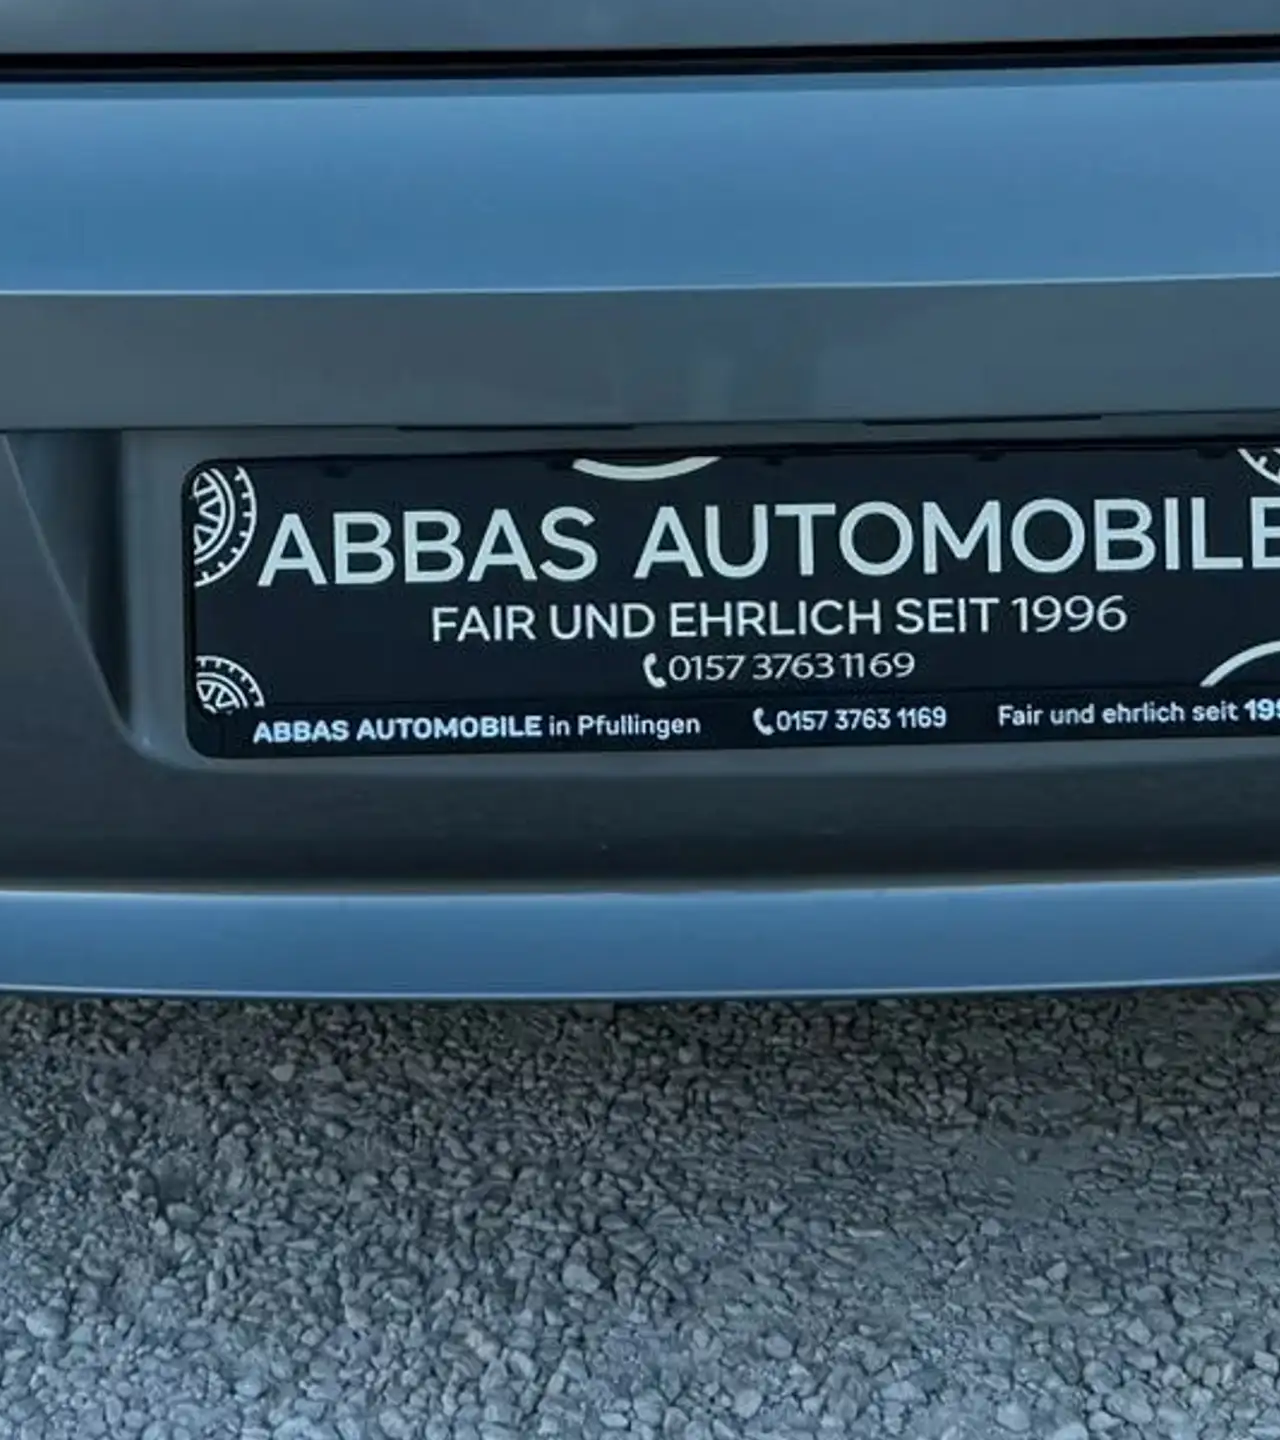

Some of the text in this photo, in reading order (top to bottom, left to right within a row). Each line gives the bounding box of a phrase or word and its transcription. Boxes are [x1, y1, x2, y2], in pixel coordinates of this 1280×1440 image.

[257, 505, 598, 587] ABBAS
[432, 594, 1128, 642] FAIR UND EHRLICH SEIT 1996
[668, 654, 746, 682] 0157
[253, 712, 701, 744] ABBAS AUTOMOBILE in Pfullingen
[776, 705, 947, 732] 0157 3763 1169
[998, 704, 1043, 727] Fair
[1050, 703, 1096, 725] und
[1102, 700, 1185, 724] ehrlich
[1192, 700, 1239, 723] seit
